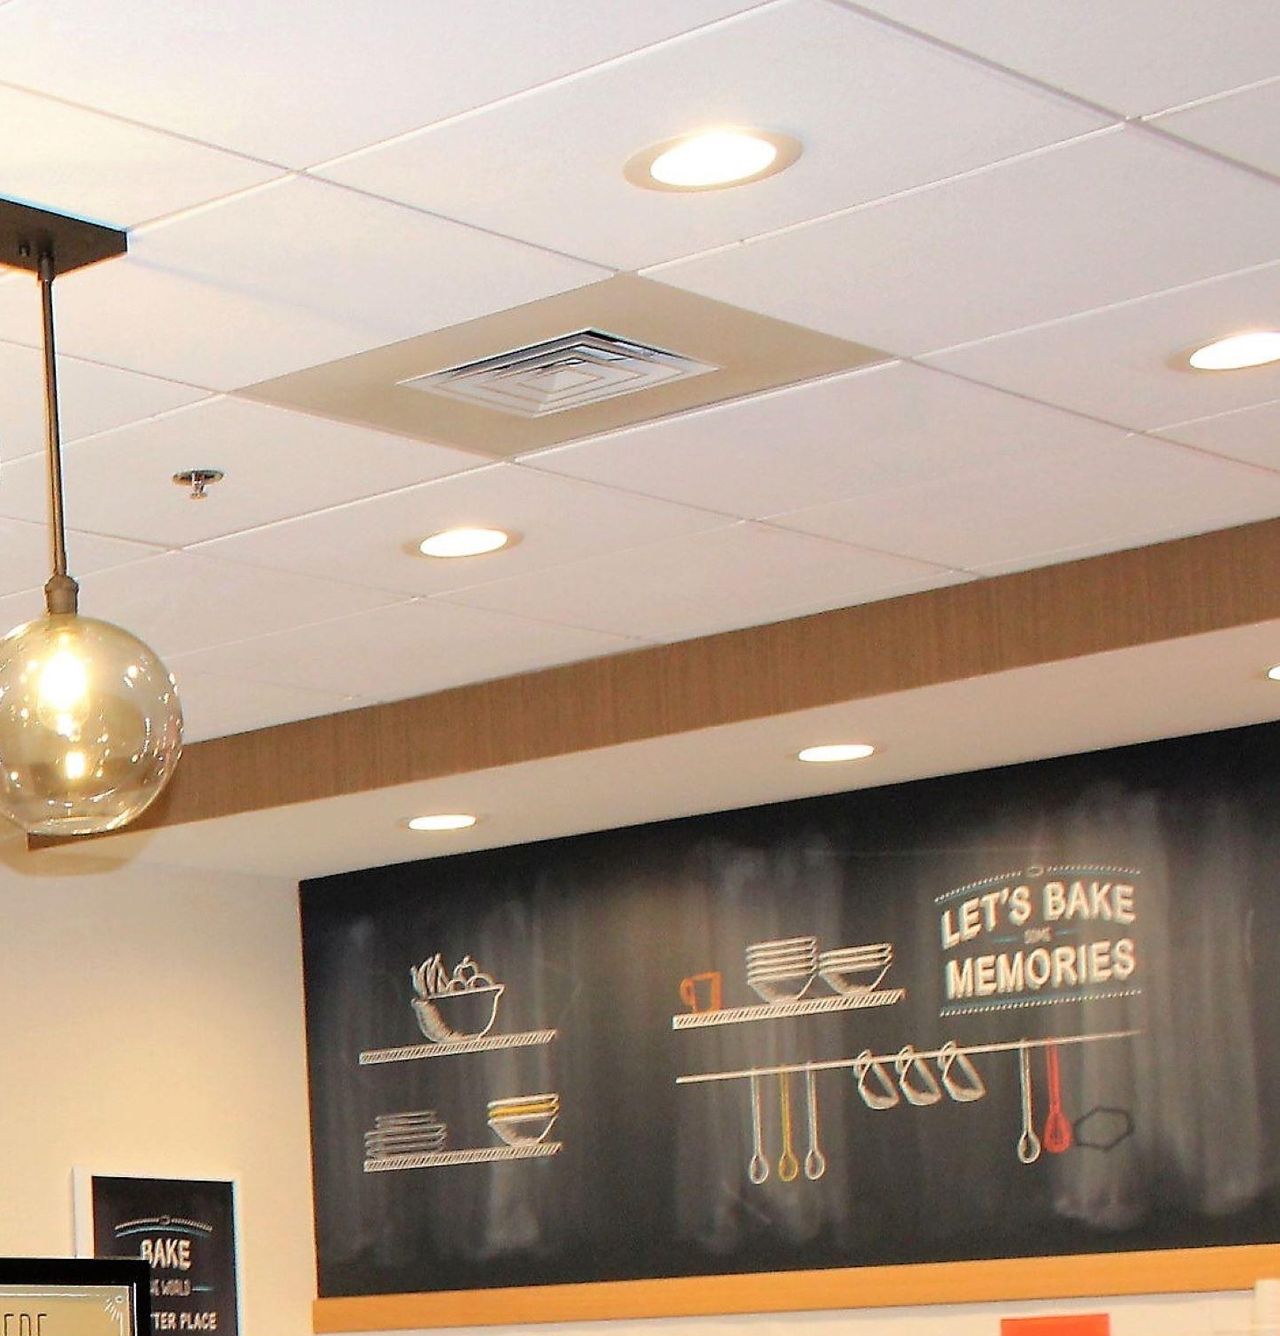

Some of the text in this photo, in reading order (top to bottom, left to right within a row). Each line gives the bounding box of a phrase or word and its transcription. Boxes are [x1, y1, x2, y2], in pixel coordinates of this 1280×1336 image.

[942, 880, 1136, 950] LET'S BAKE
[947, 938, 1136, 999] MEMORIES
[141, 1238, 192, 1270] BAKE
[180, 1311, 217, 1330] PLACE
